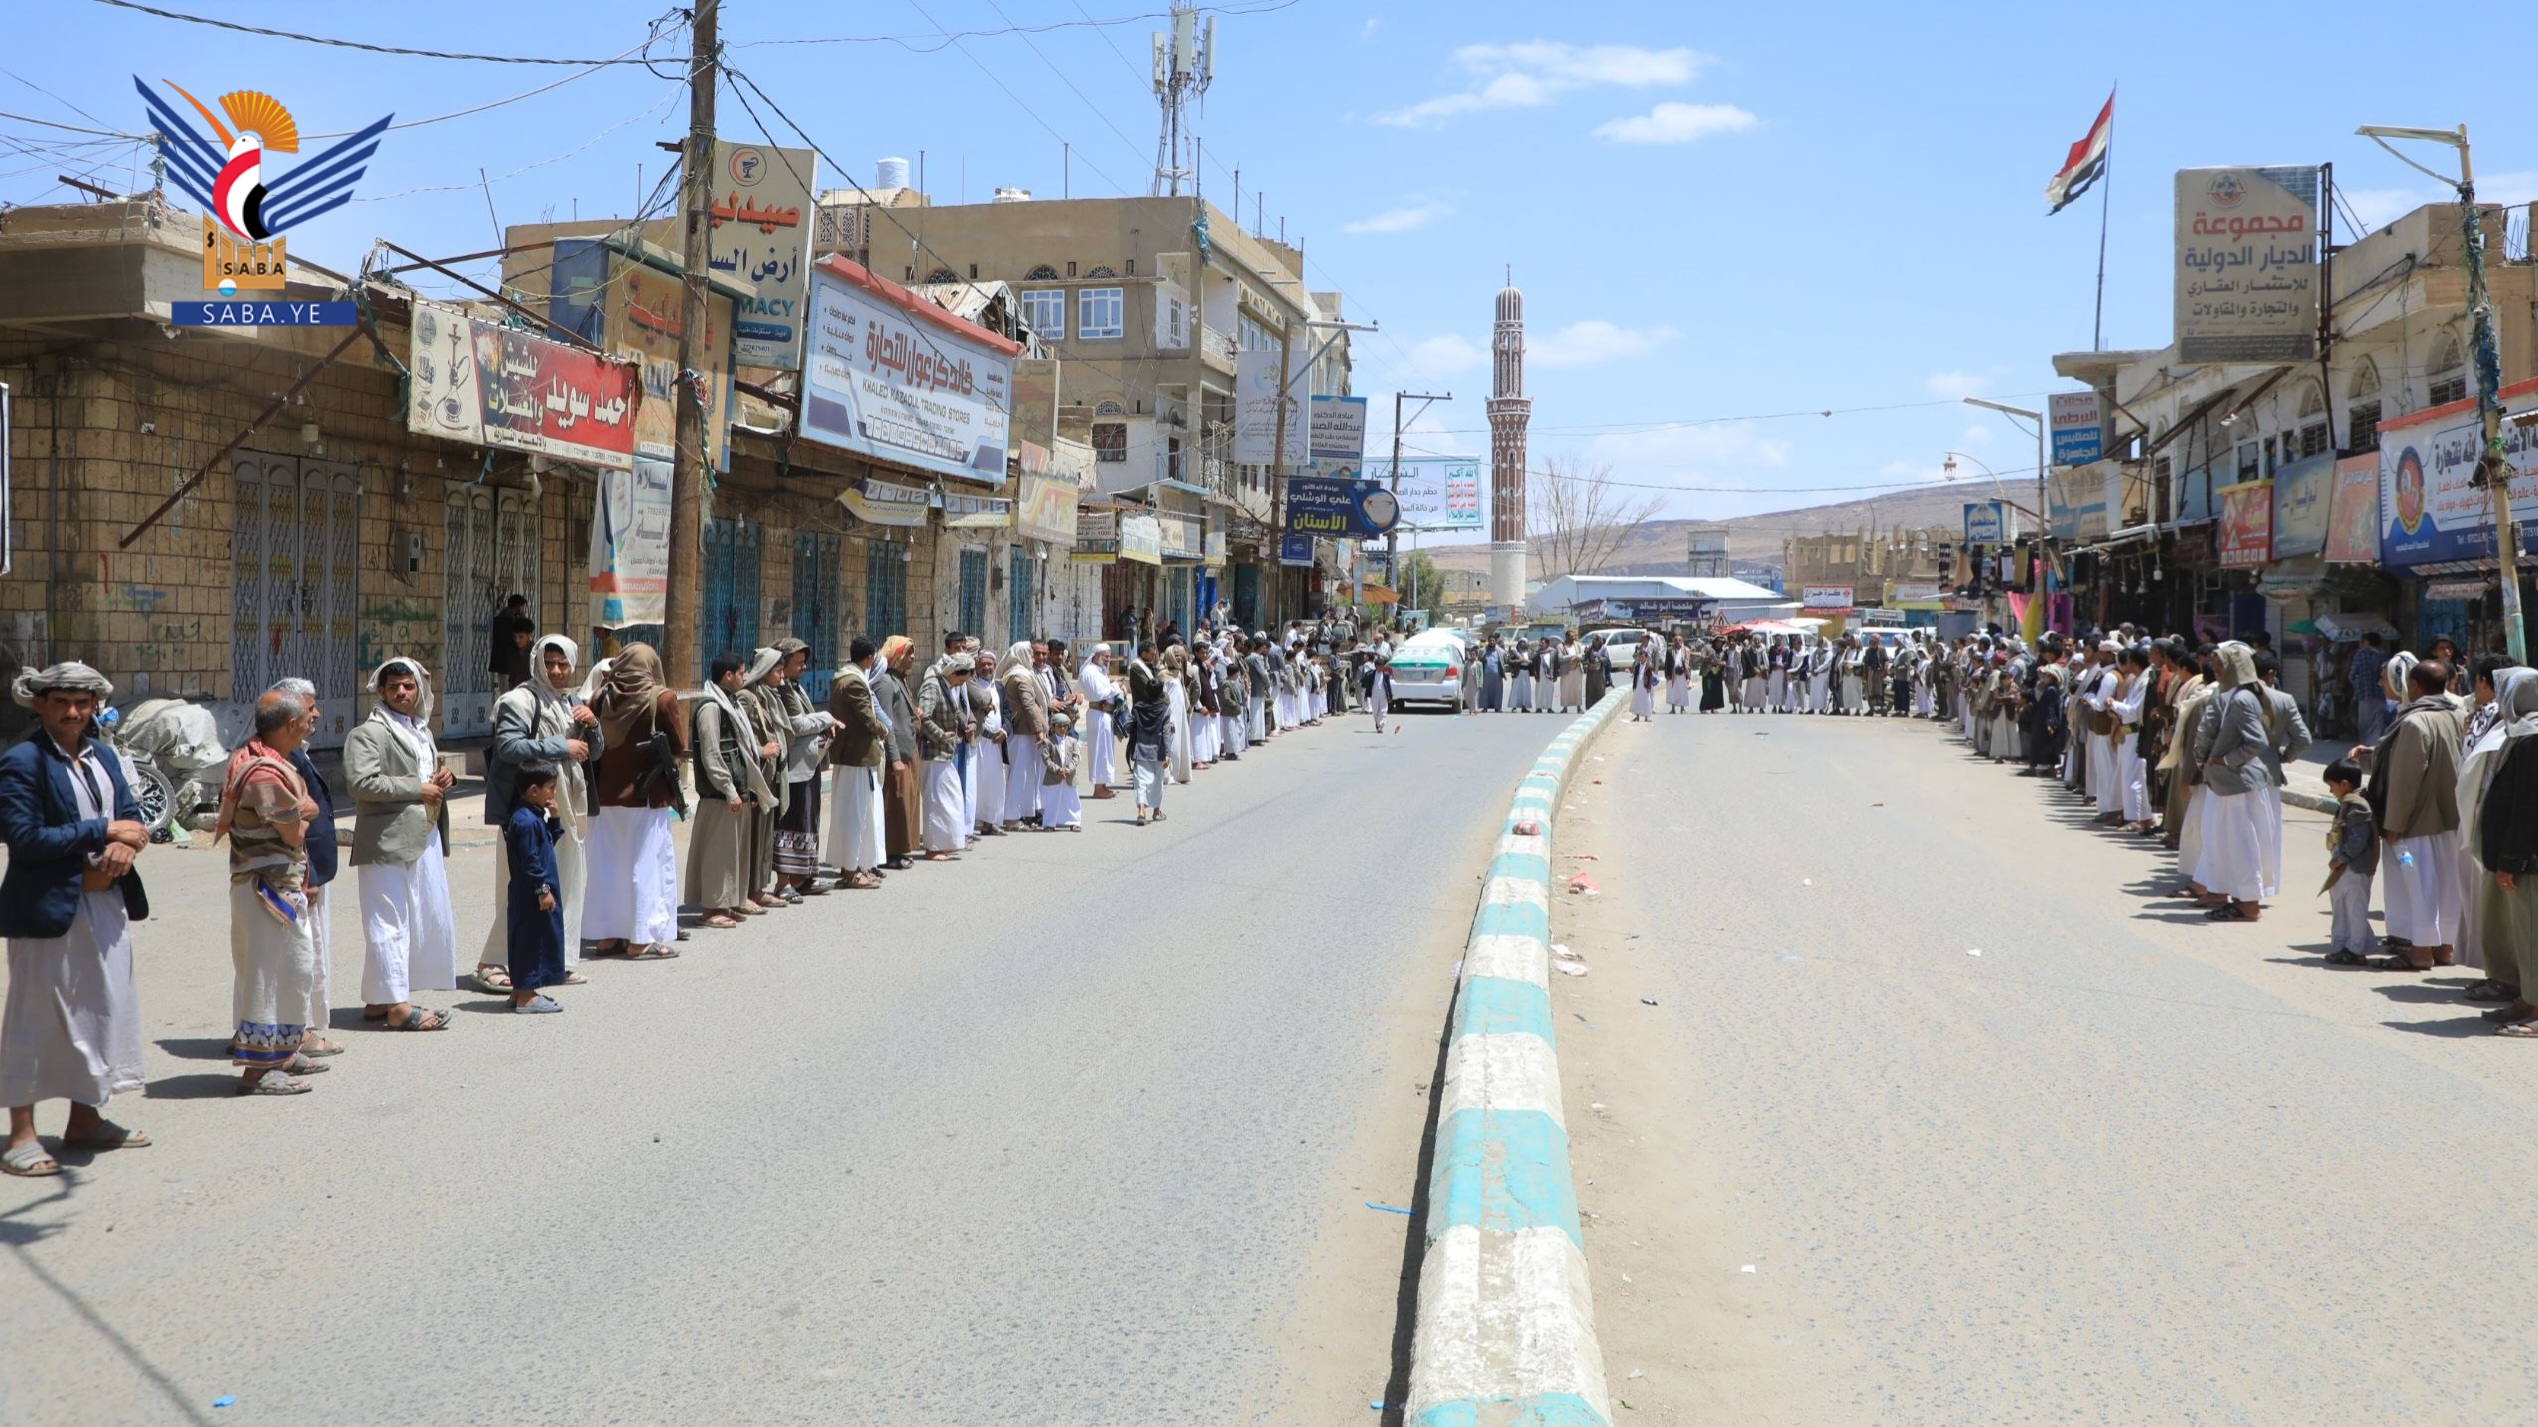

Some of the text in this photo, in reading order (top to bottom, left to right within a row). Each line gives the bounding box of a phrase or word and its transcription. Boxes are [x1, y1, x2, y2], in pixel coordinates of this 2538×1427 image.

[711, 190, 800, 234] صيدلي
[2192, 211, 2304, 242] مجموعة
[752, 247, 798, 283] أرض
[2185, 243, 2313, 273] الديار الدولية
[2187, 280, 2240, 298] العقاري
[2192, 300, 2299, 319] والتجارة والمقاولات
[866, 320, 908, 378] للتجارة
[948, 358, 973, 396] خالد
[546, 372, 590, 429] سويد
[594, 379, 632, 428] أحمد
[921, 399, 947, 418] TRADING
[949, 407, 971, 425] STORES
[1313, 411, 1337, 419] الدكتور
[2057, 446, 2098, 460] الجاهزة
[1465, 467, 1477, 477] الله
[1289, 491, 1352, 506] علي الوشلي
[1302, 483, 1323, 491] الدكتور
[1293, 511, 1347, 531] الأسنان
